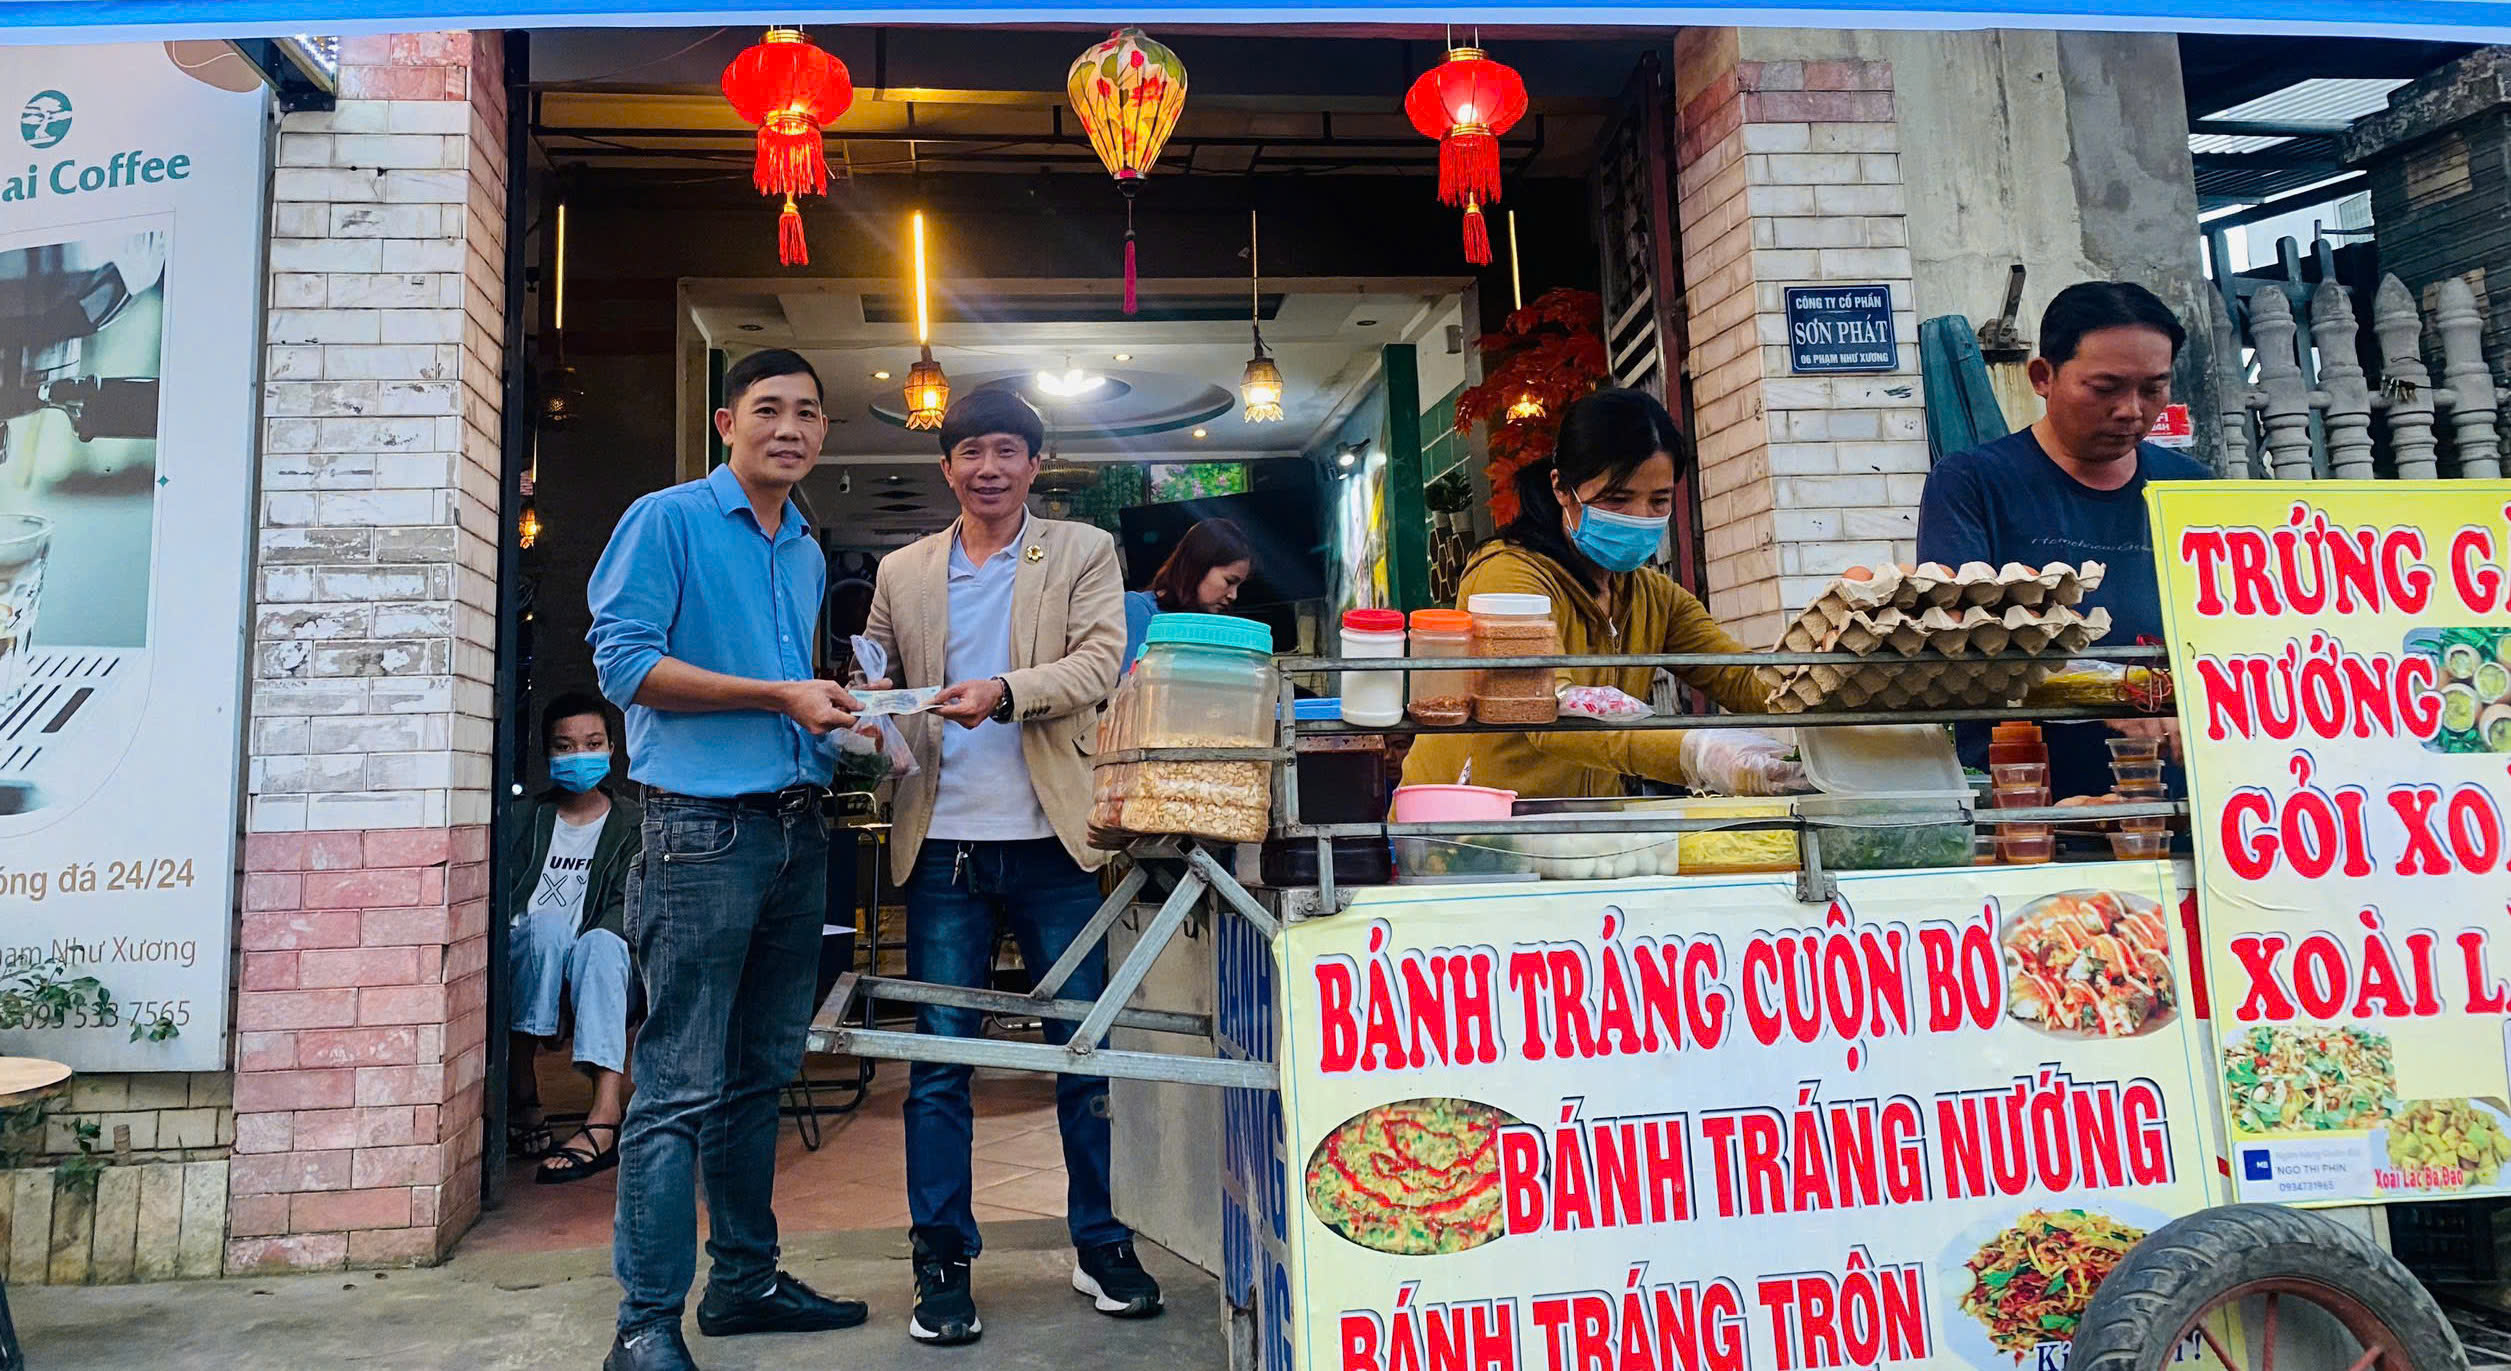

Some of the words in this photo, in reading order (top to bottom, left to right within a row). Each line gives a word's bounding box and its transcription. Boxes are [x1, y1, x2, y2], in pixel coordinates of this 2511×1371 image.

[49, 150, 191, 195] Coffee
[1794, 318, 1833, 345] SƠN
[1836, 313, 1889, 344] PHÁT
[1824, 297, 1837, 309] TY
[2181, 504, 2433, 617] TRỨNG
[2450, 505, 2511, 616] G
[2196, 632, 2443, 742] NƯỚNG
[2220, 754, 2373, 881] GỎI
[2386, 764, 2511, 877] XO
[58, 861, 97, 894] đá
[106, 858, 195, 891] 24/24
[51, 937, 106, 968] Như
[111, 936, 196, 968] Xương
[1314, 925, 1498, 1074] BÁNH
[1508, 913, 1728, 1062] TRÁNG
[1742, 902, 1908, 1073] CUỘN
[1918, 904, 2003, 1033] BƠ
[2229, 909, 2441, 1022] XOÀI
[2455, 930, 2511, 1015] L
[129, 1000, 190, 1028] 7565
[1501, 1102, 1689, 1237] BÁNH
[1702, 1086, 1925, 1219] TRÁNG
[1936, 1068, 2170, 1200] NƯỚNG
[1340, 1286, 1515, 1371] BÁNH
[1532, 1266, 1746, 1371] TRÁNG
